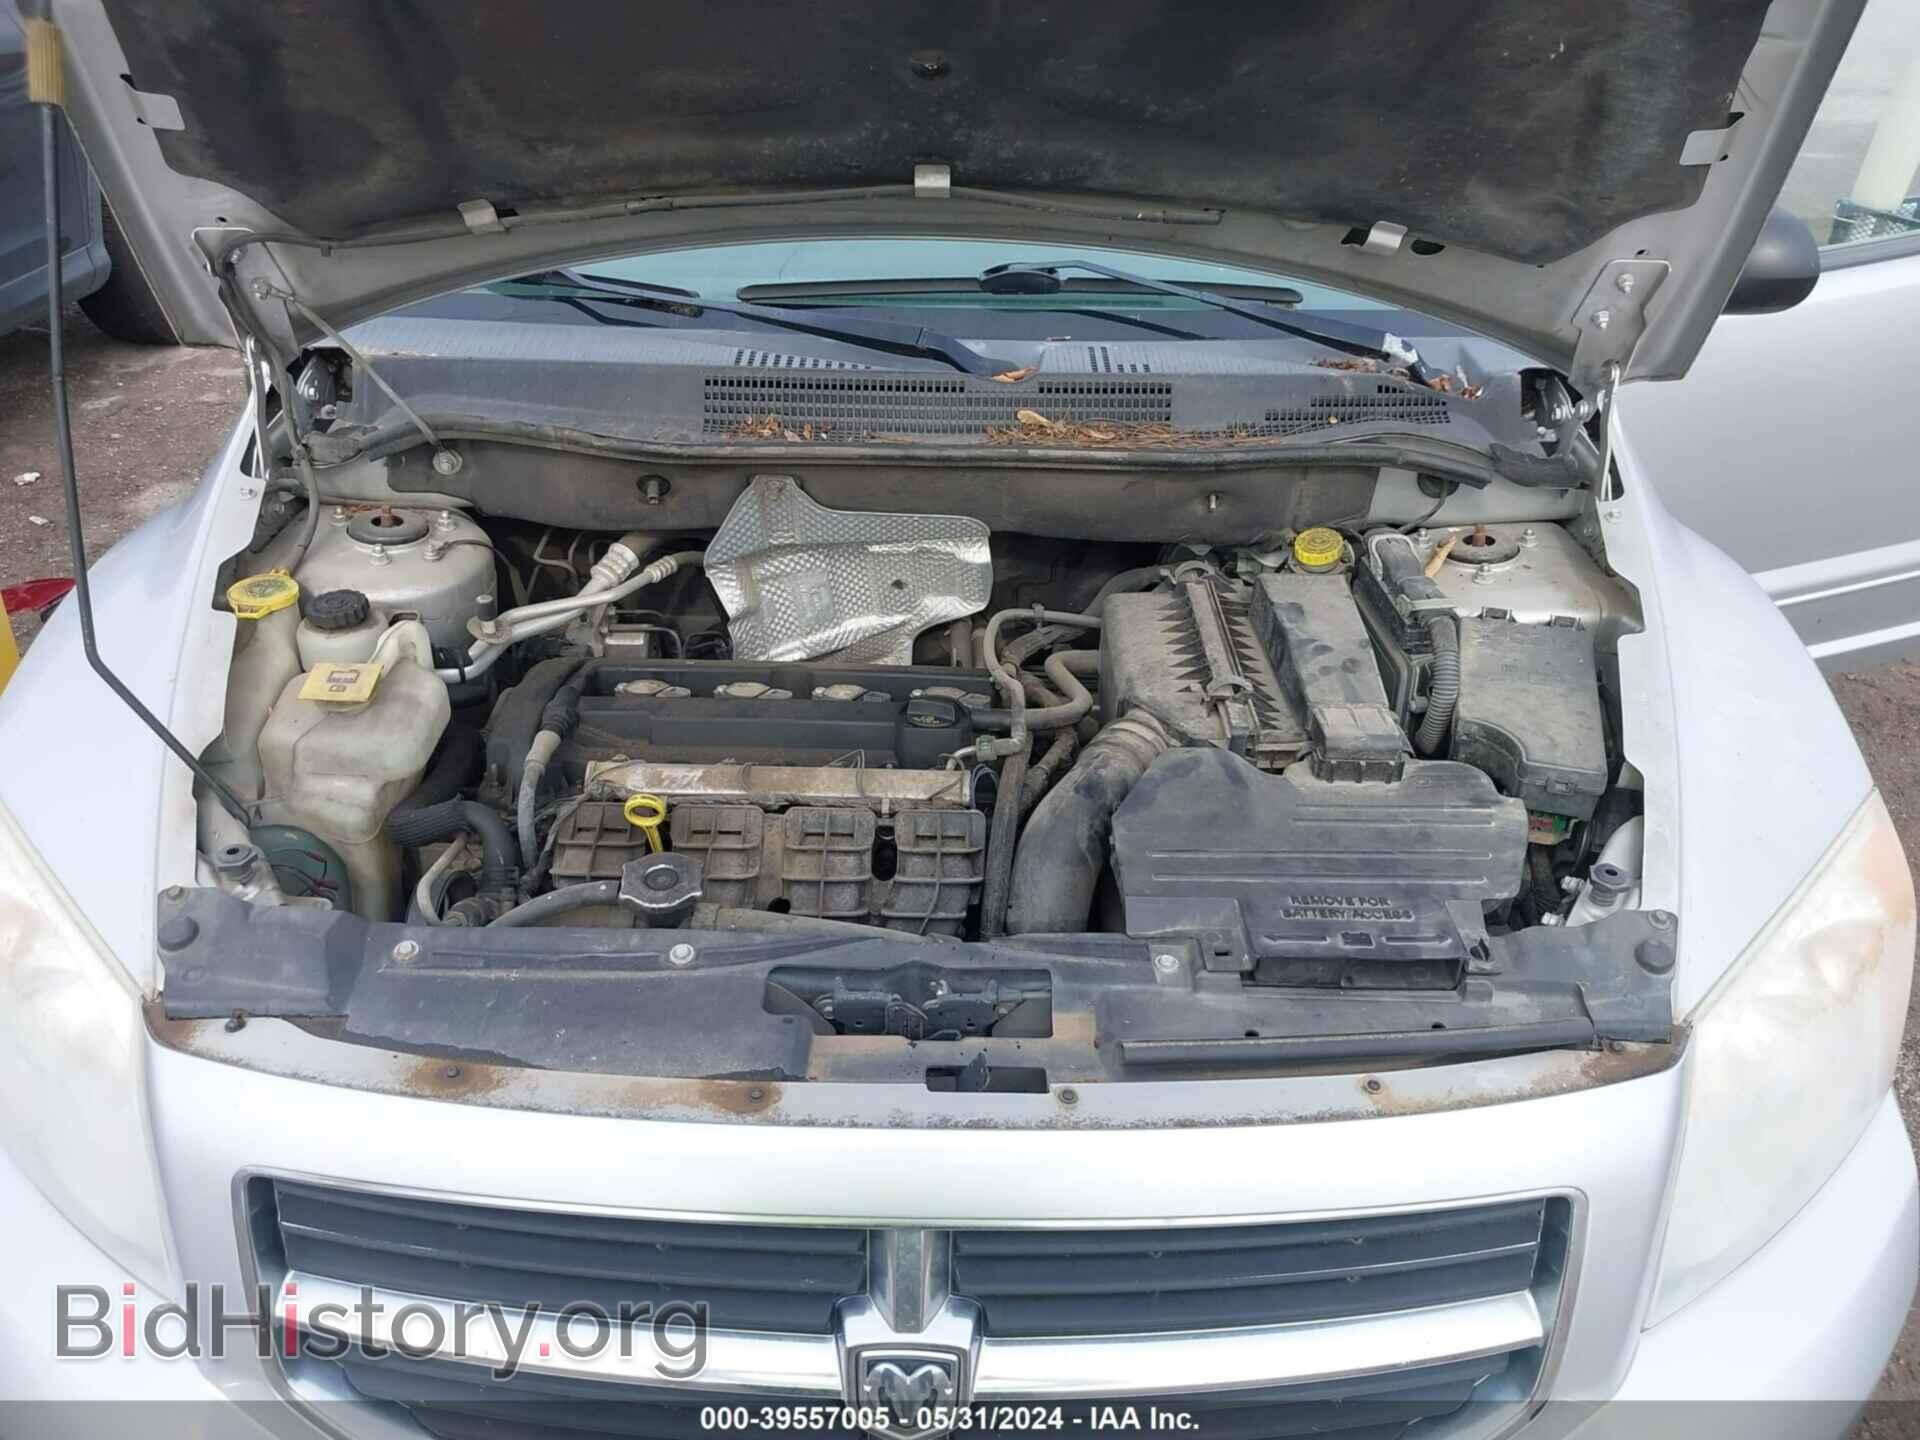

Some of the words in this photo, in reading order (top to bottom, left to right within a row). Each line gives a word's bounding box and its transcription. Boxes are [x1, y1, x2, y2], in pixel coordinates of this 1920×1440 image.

[1288, 895, 1355, 907] REMOVE
[1356, 896, 1391, 907] FOR
[1281, 908, 1348, 920] BATTERY
[1351, 909, 1414, 921] ACCESS
